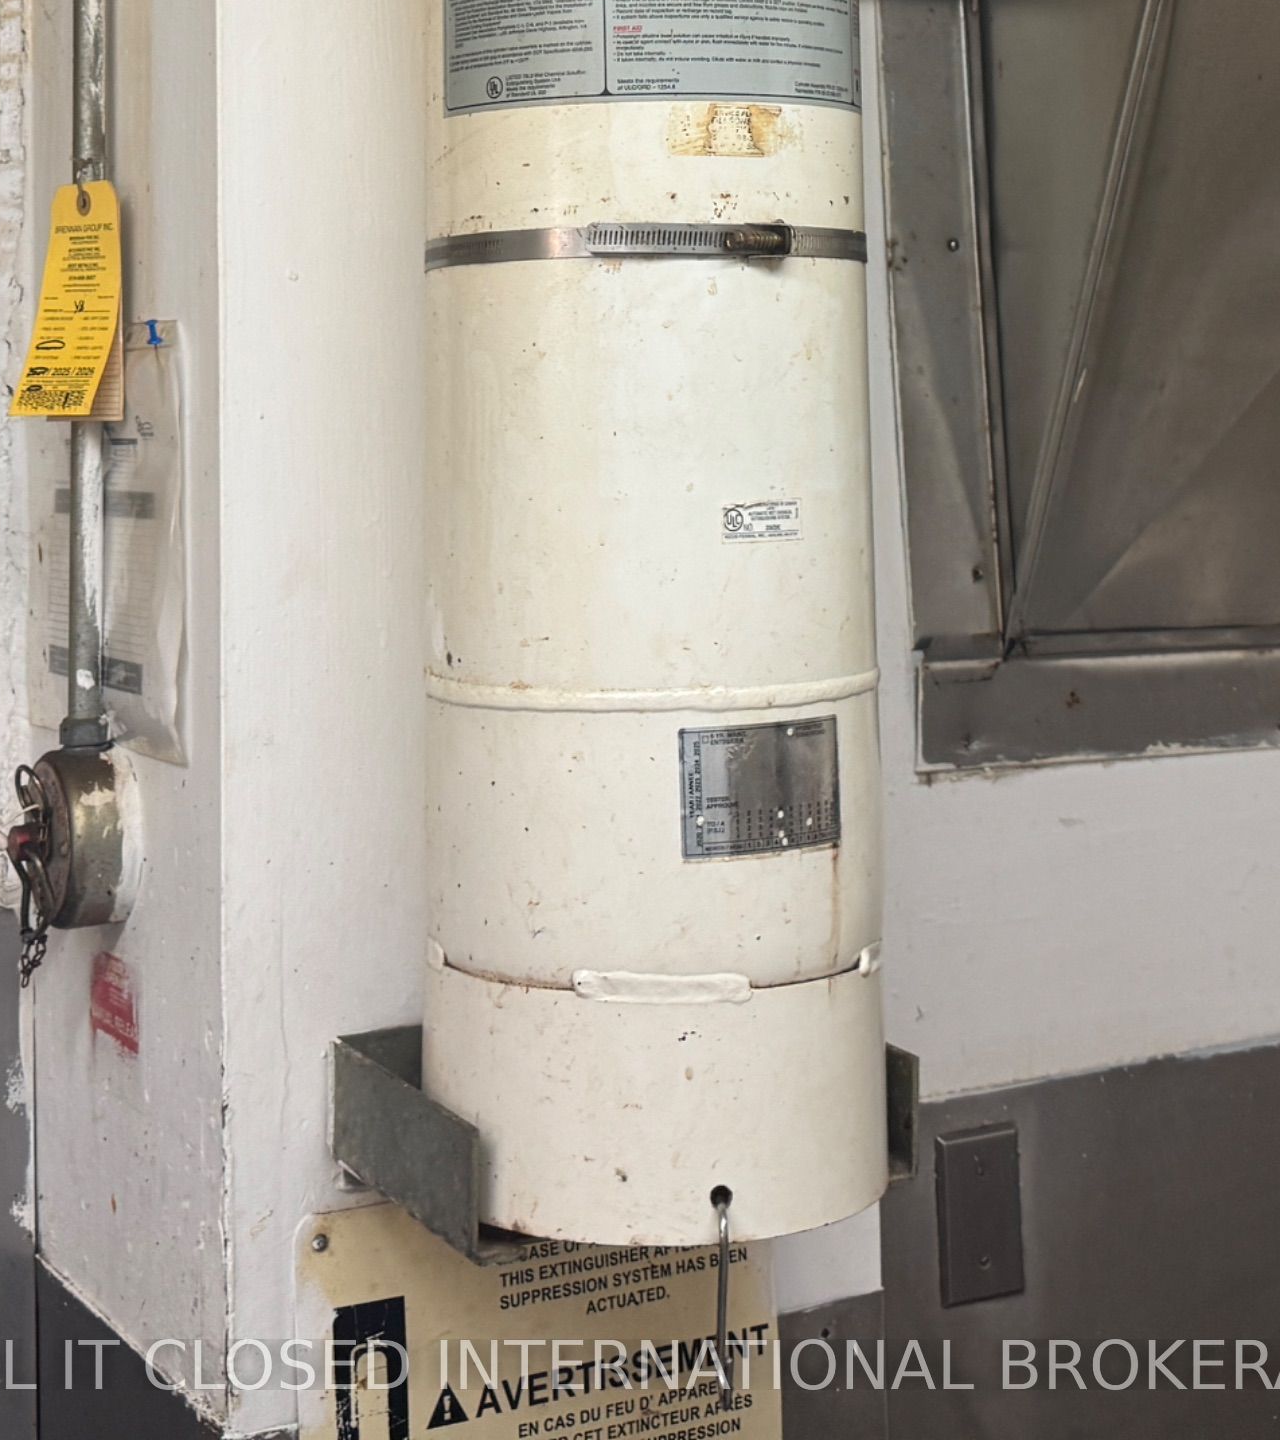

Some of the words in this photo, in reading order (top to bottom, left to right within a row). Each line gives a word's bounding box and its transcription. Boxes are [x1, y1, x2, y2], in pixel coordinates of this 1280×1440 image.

[500, 1268, 534, 1288] THIS
[539, 1246, 648, 1280] EXTINGUISHER
[524, 1241, 559, 1261] ASE
[500, 1276, 608, 1310] SUPPRESSION
[612, 1261, 672, 1287] SYSTEM
[676, 1254, 705, 1275] HAS
[709, 1247, 748, 1268] BEN
[586, 1286, 670, 1315] ACTUATED.
[519, 1420, 539, 1438] EN
[544, 1412, 575, 1432] CAS
[581, 1406, 601, 1423] DU
[606, 1399, 634, 1418] FEU
[607, 1405, 700, 1440] EXTINCTEUR
